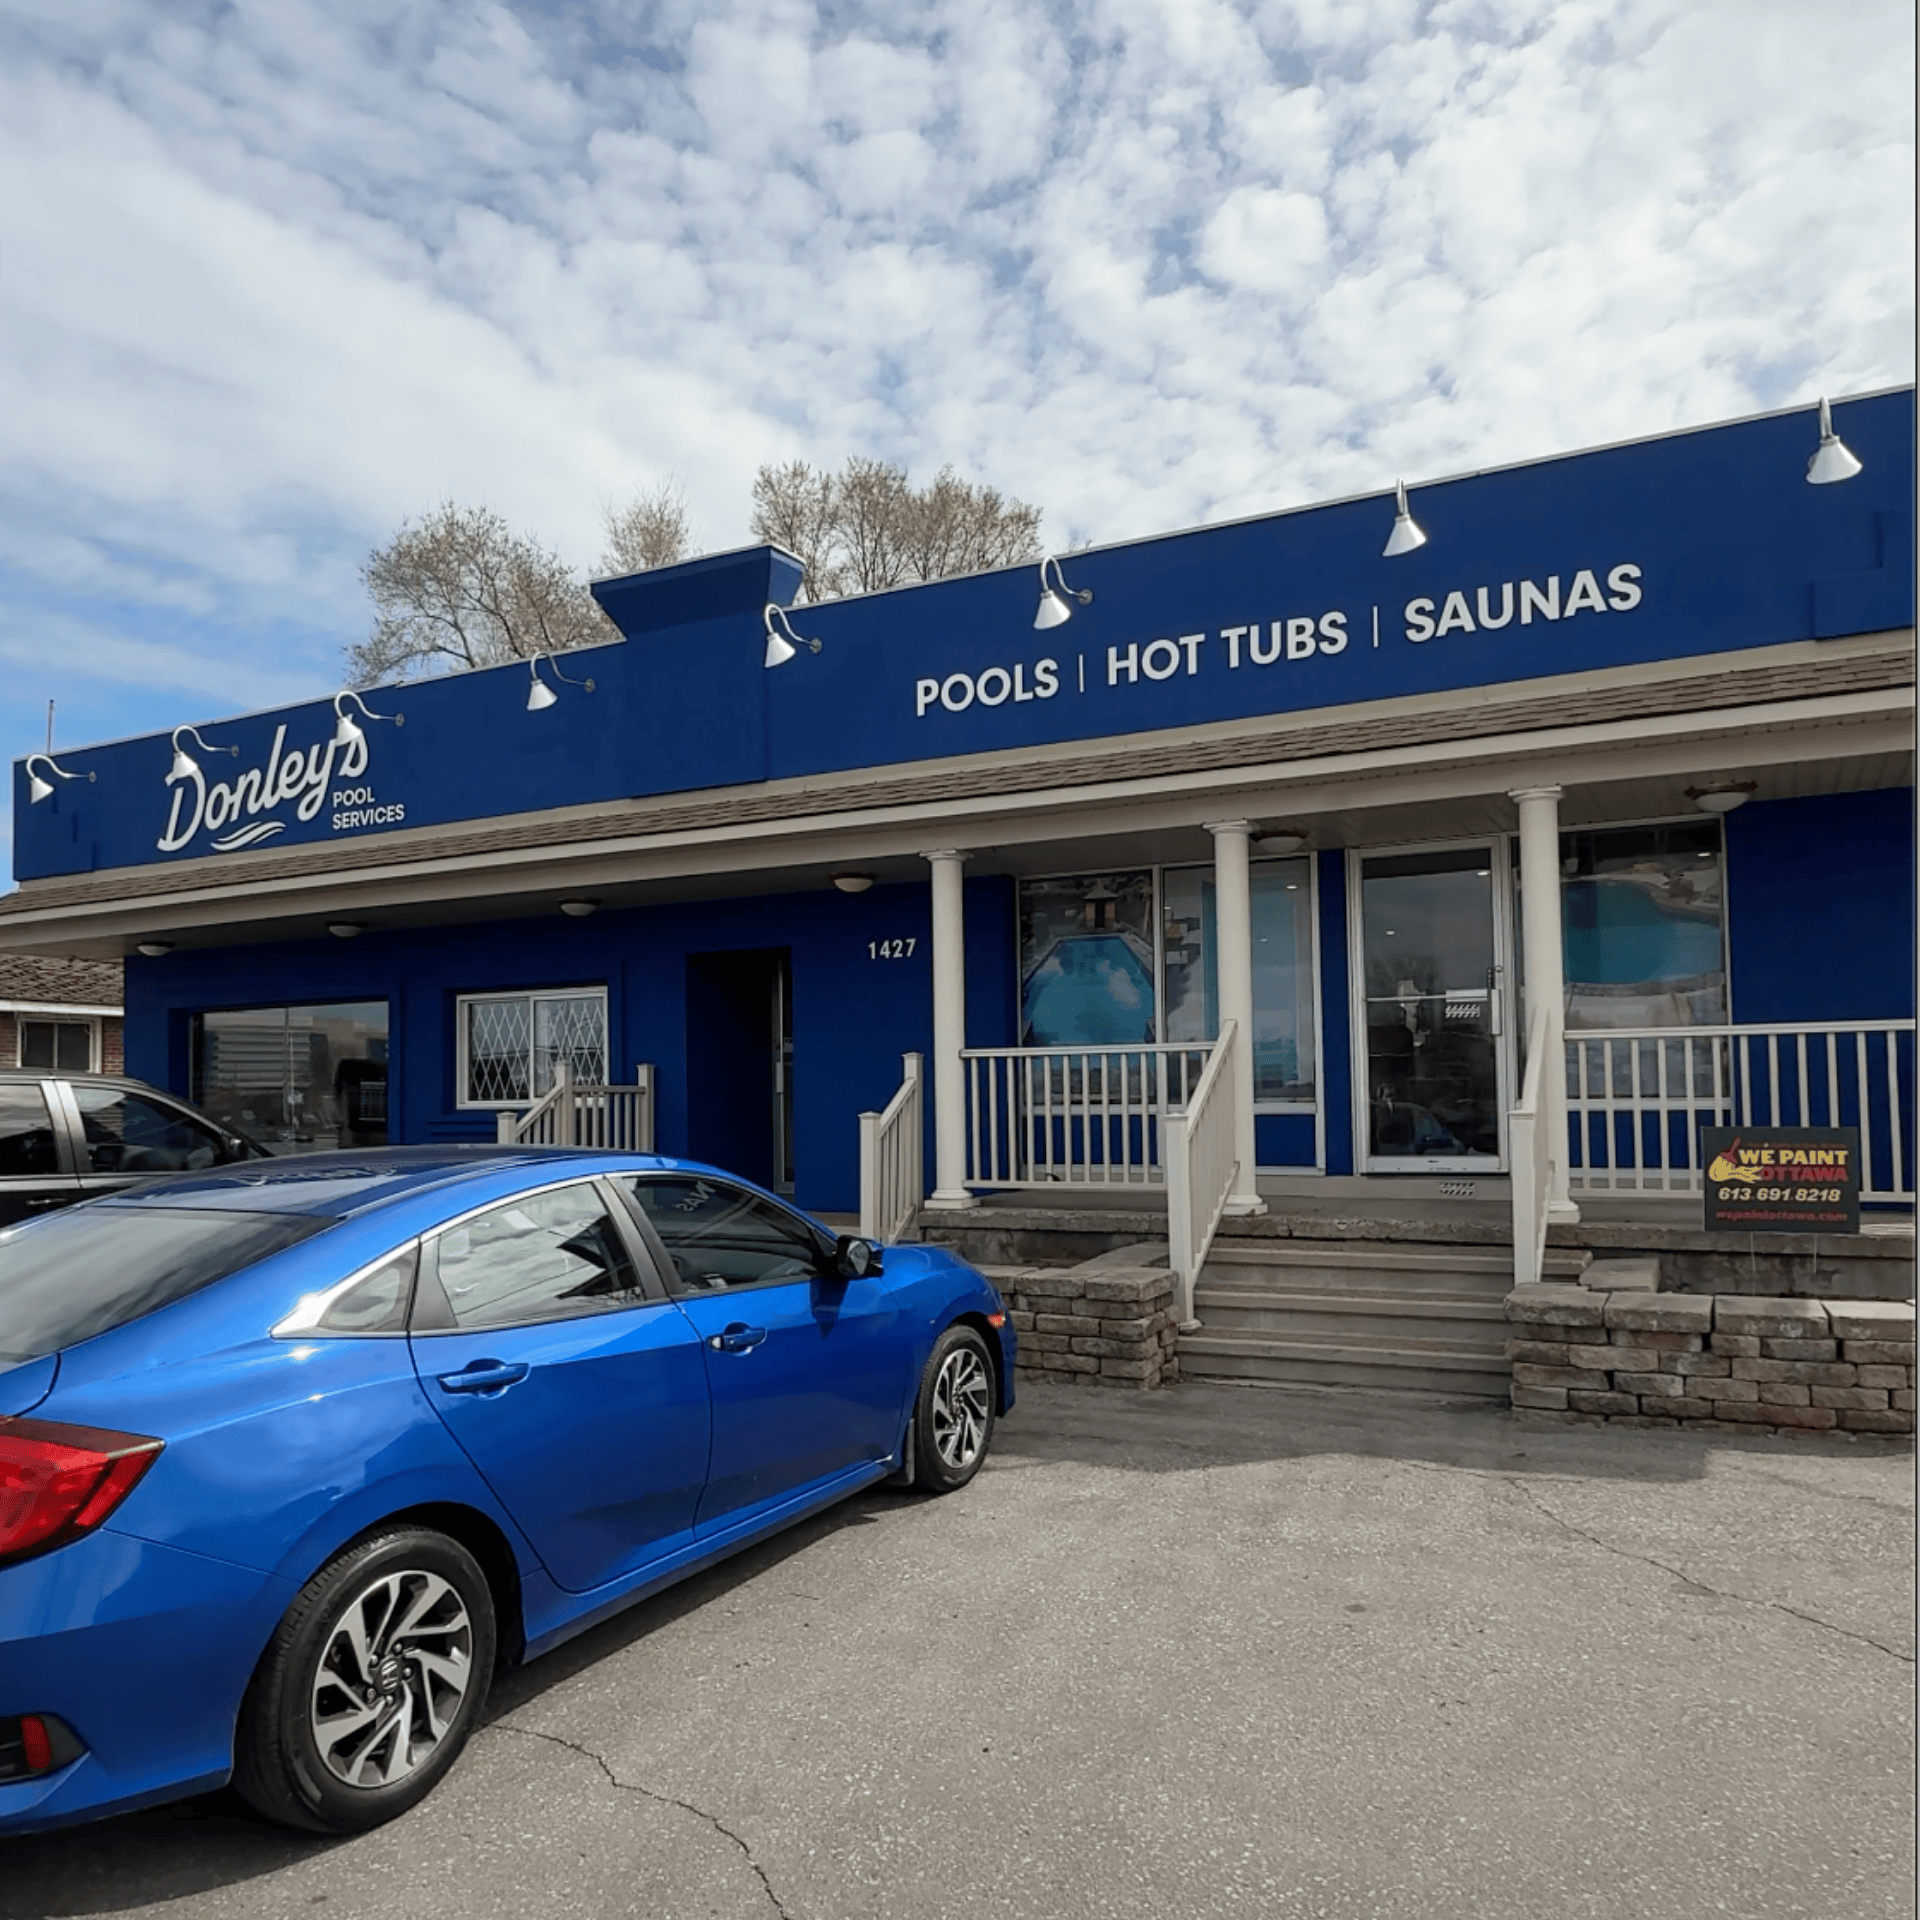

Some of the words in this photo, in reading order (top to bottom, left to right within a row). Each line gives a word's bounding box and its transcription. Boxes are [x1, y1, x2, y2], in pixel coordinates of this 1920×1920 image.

[917, 658, 1059, 717] POOLS
[1107, 634, 1205, 686] HOT
[1220, 611, 1348, 669] TUBS
[1404, 563, 1642, 643] SAUNAS
[157, 713, 369, 851] Donleys
[333, 786, 375, 808] POOL
[332, 803, 405, 830] SERVICES
[868, 937, 917, 960] 1427
[1738, 1150, 1775, 1165] WE
[1779, 1150, 1849, 1165] PAINT
[1760, 1167, 1849, 1182] OTTAWA
